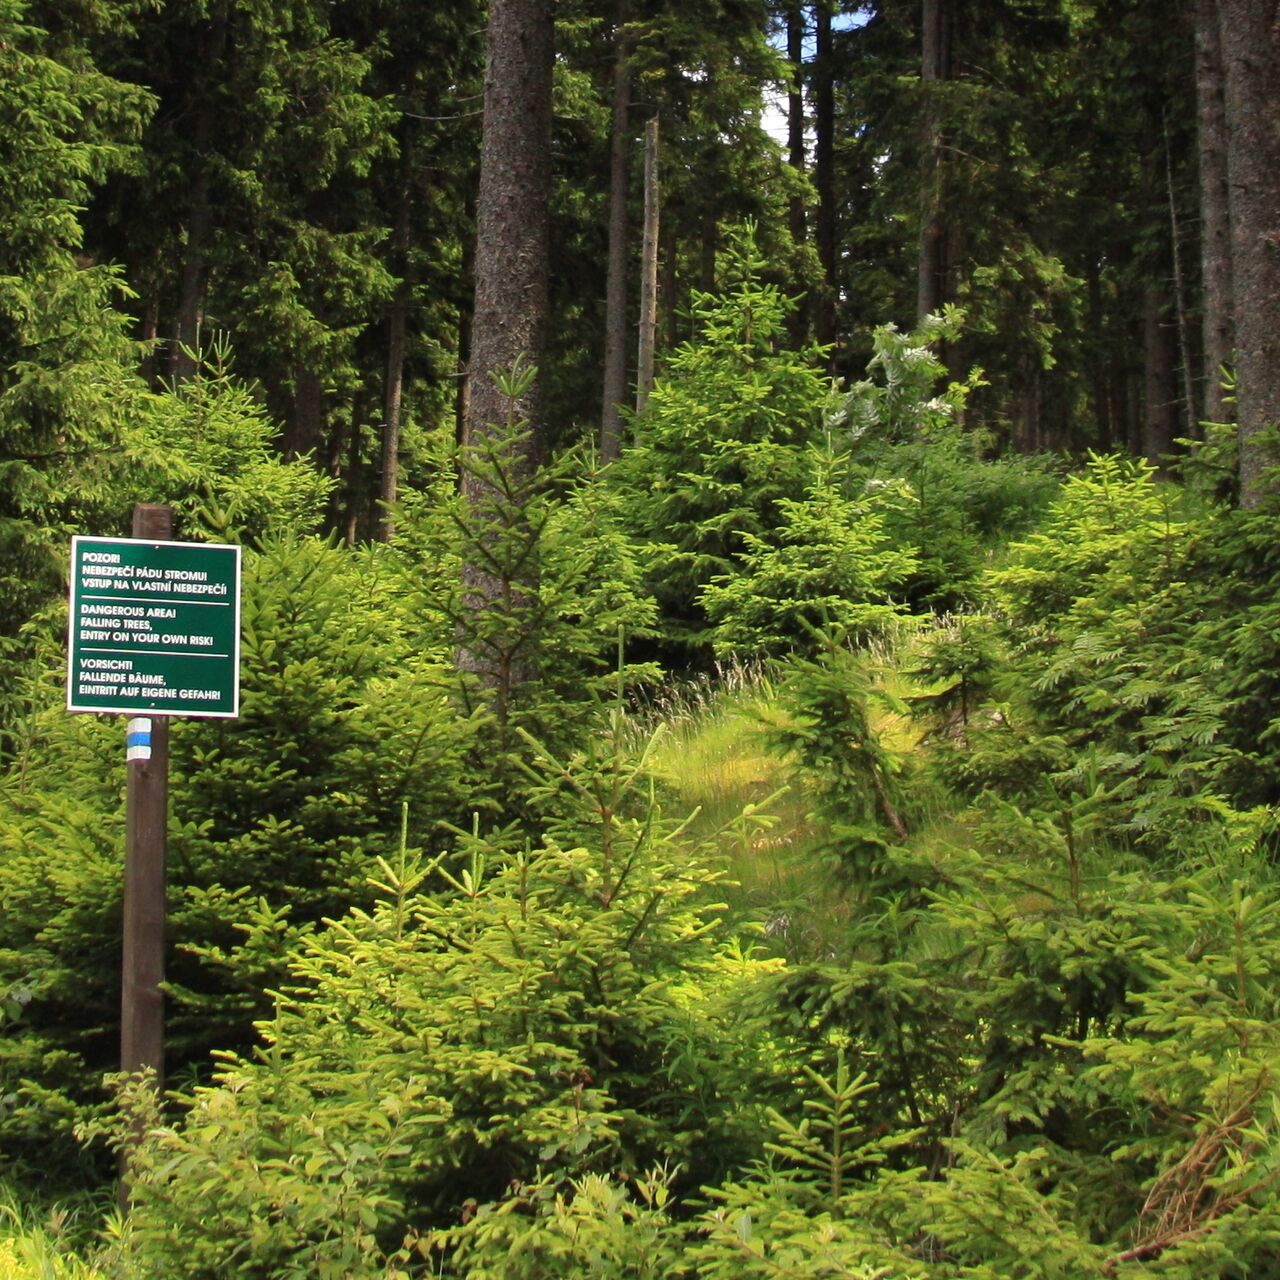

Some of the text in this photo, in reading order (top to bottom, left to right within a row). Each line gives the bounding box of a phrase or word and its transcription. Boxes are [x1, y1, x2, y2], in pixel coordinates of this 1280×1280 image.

[82, 552, 120, 563] POZOR!
[82, 566, 134, 577] NEBEZPEČÍ
[136, 566, 162, 579] PÁDU
[82, 578, 227, 594] VSTUP NA VLASTNÍ NEBEZPEČÍ!
[81, 605, 176, 617] DANGEROUS AREA!
[81, 618, 152, 631] FALLING TREES,
[80, 631, 212, 645] ENTRY ON YOUR OWN RISK!
[80, 659, 132, 670] VORSICHT!
[80, 672, 166, 685] FALLENDE BÄUME,
[80, 686, 220, 699] EINTRITT AUF EIGENE GEFAHR!
